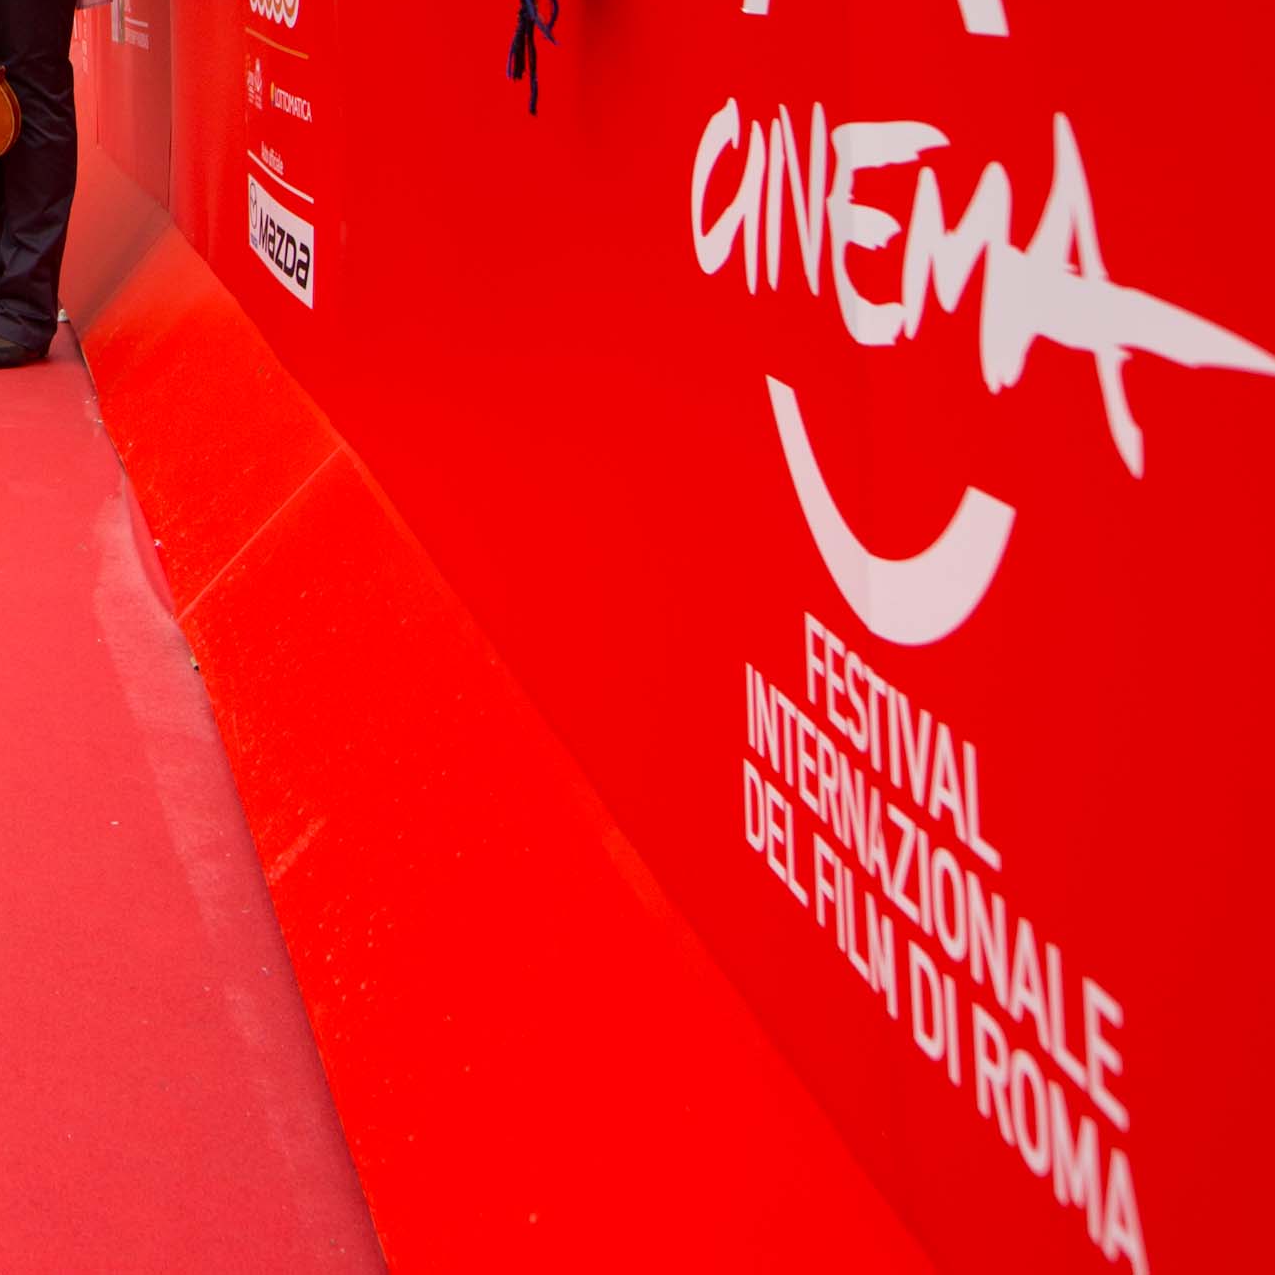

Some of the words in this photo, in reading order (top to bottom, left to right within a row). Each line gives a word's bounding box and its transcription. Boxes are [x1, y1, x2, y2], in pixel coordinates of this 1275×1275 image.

[691, 98, 1275, 478] CINEMA
[745, 662, 1130, 1132] INTERNAZIONALE
[804, 611, 1002, 871] FESTIVAL
[743, 758, 808, 907] DEL
[813, 833, 899, 1019] FILM
[908, 940, 961, 1085] DI
[972, 1002, 1151, 1275] ROMA
